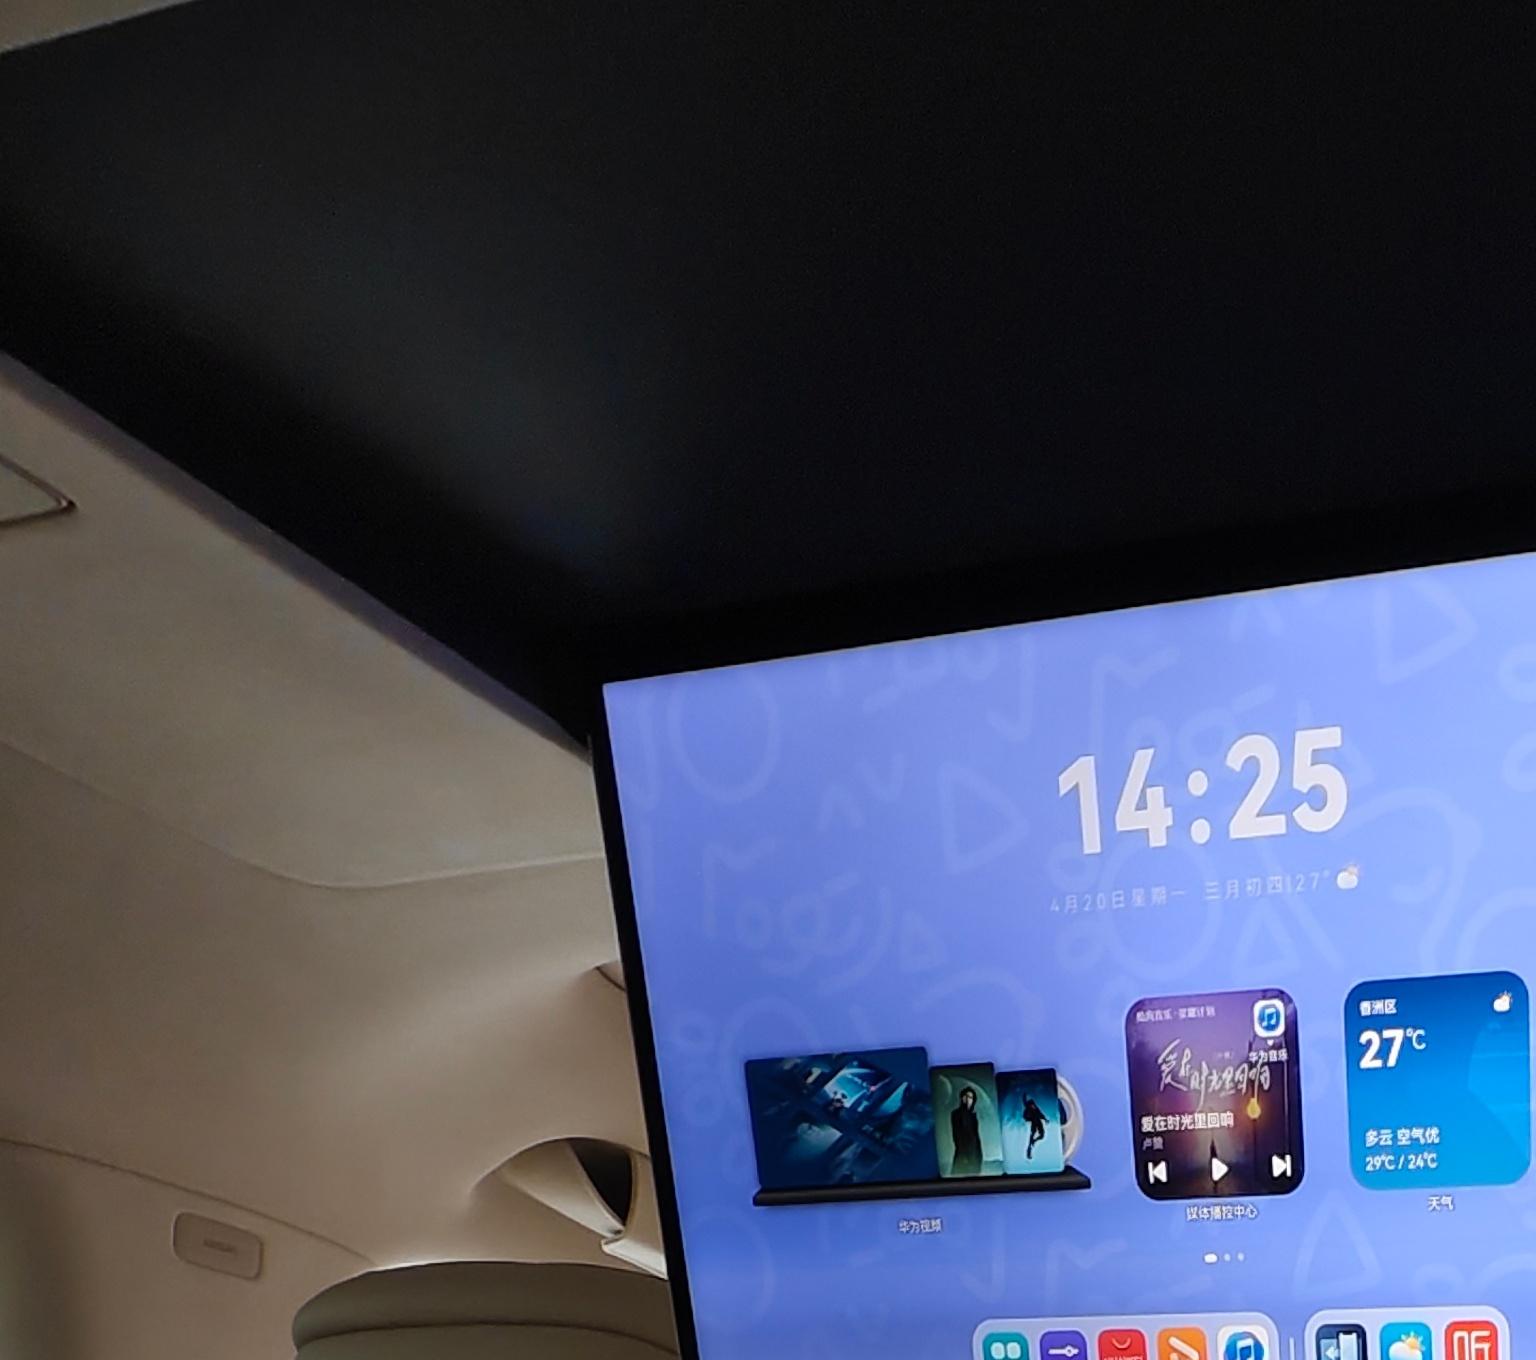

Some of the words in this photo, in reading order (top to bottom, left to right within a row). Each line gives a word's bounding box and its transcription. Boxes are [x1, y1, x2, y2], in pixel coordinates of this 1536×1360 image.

[1058, 726, 1348, 855] 14:25
[1140, 1111, 1235, 1133] 爱在时光里回响
[1365, 1129, 1393, 1148] 多云
[1397, 1127, 1440, 1146] 空气优
[1186, 1204, 1258, 1221] 媒体播控中心
[1428, 1196, 1454, 1211] 天气
